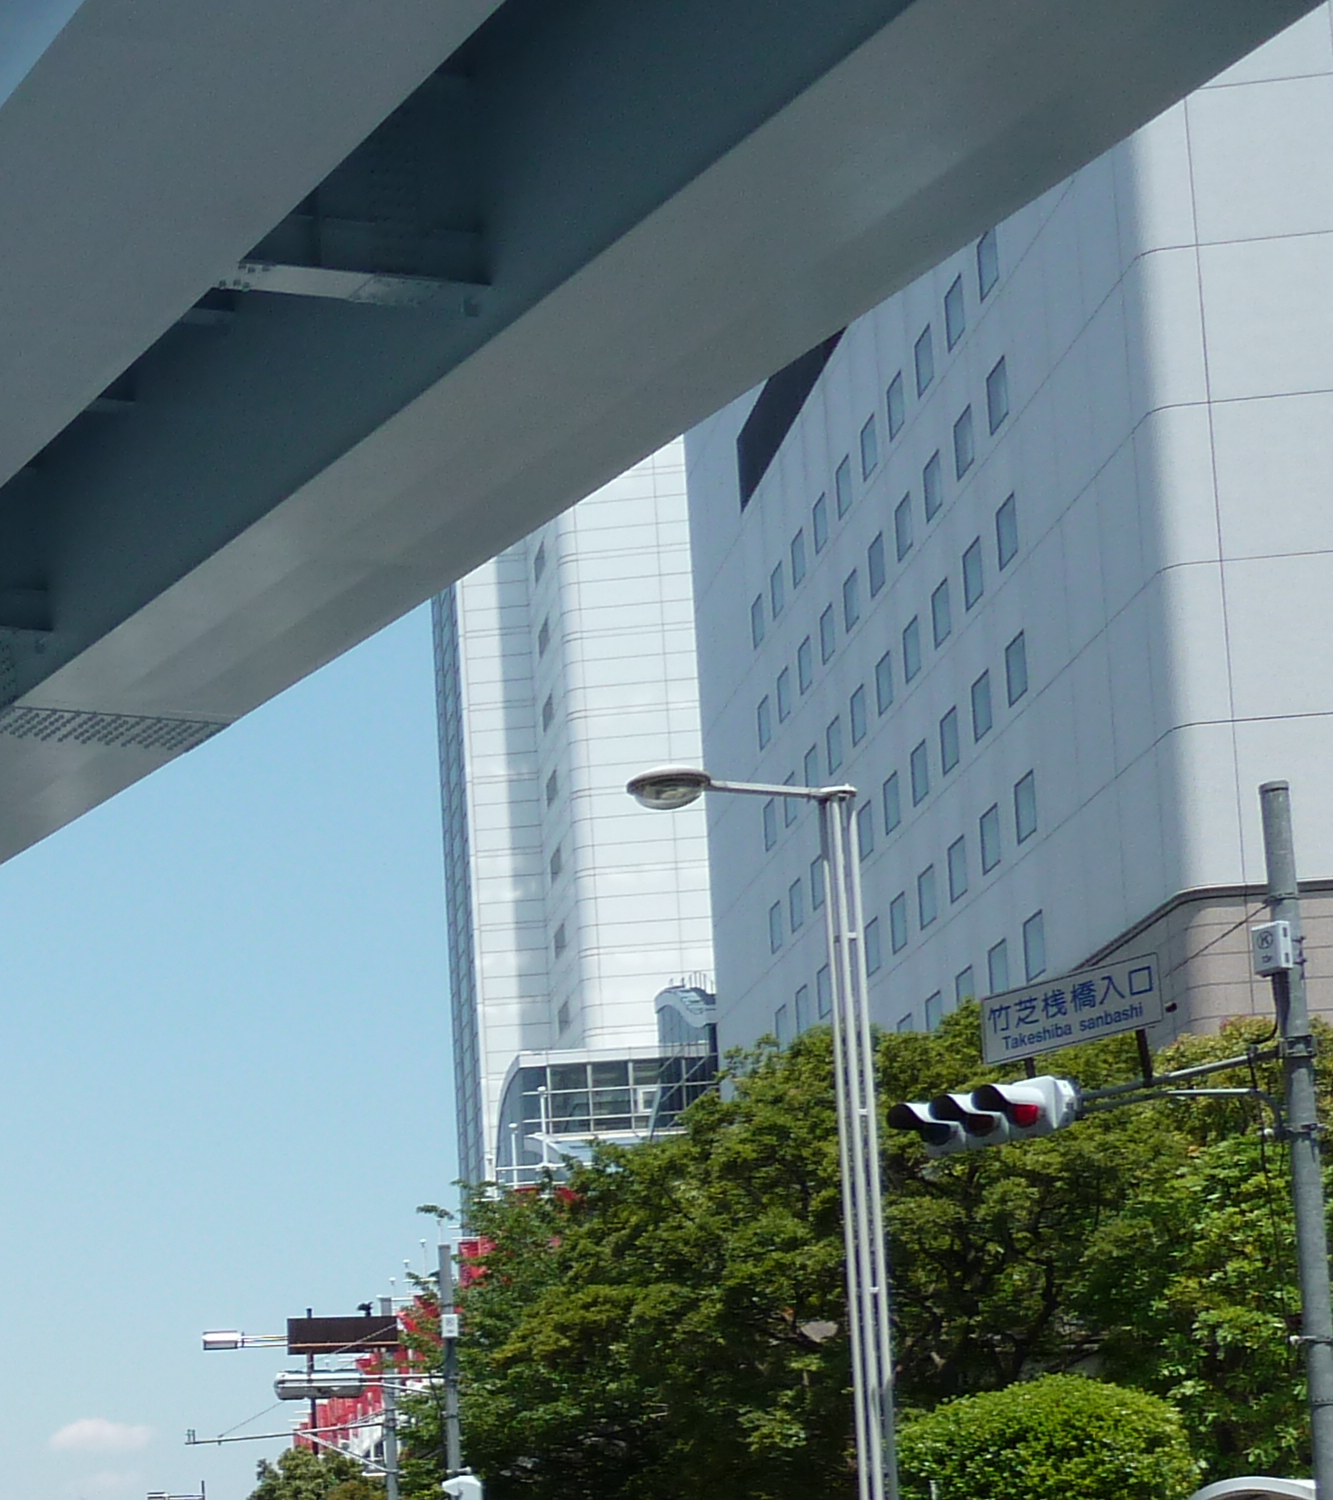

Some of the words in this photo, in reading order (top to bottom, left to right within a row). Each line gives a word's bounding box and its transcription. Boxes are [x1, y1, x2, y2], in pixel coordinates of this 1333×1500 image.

[987, 965, 1154, 1034] 竹芝桟橋入口
[1002, 1022, 1073, 1051] Takeshiba
[1079, 1002, 1144, 1032] sanbashi
